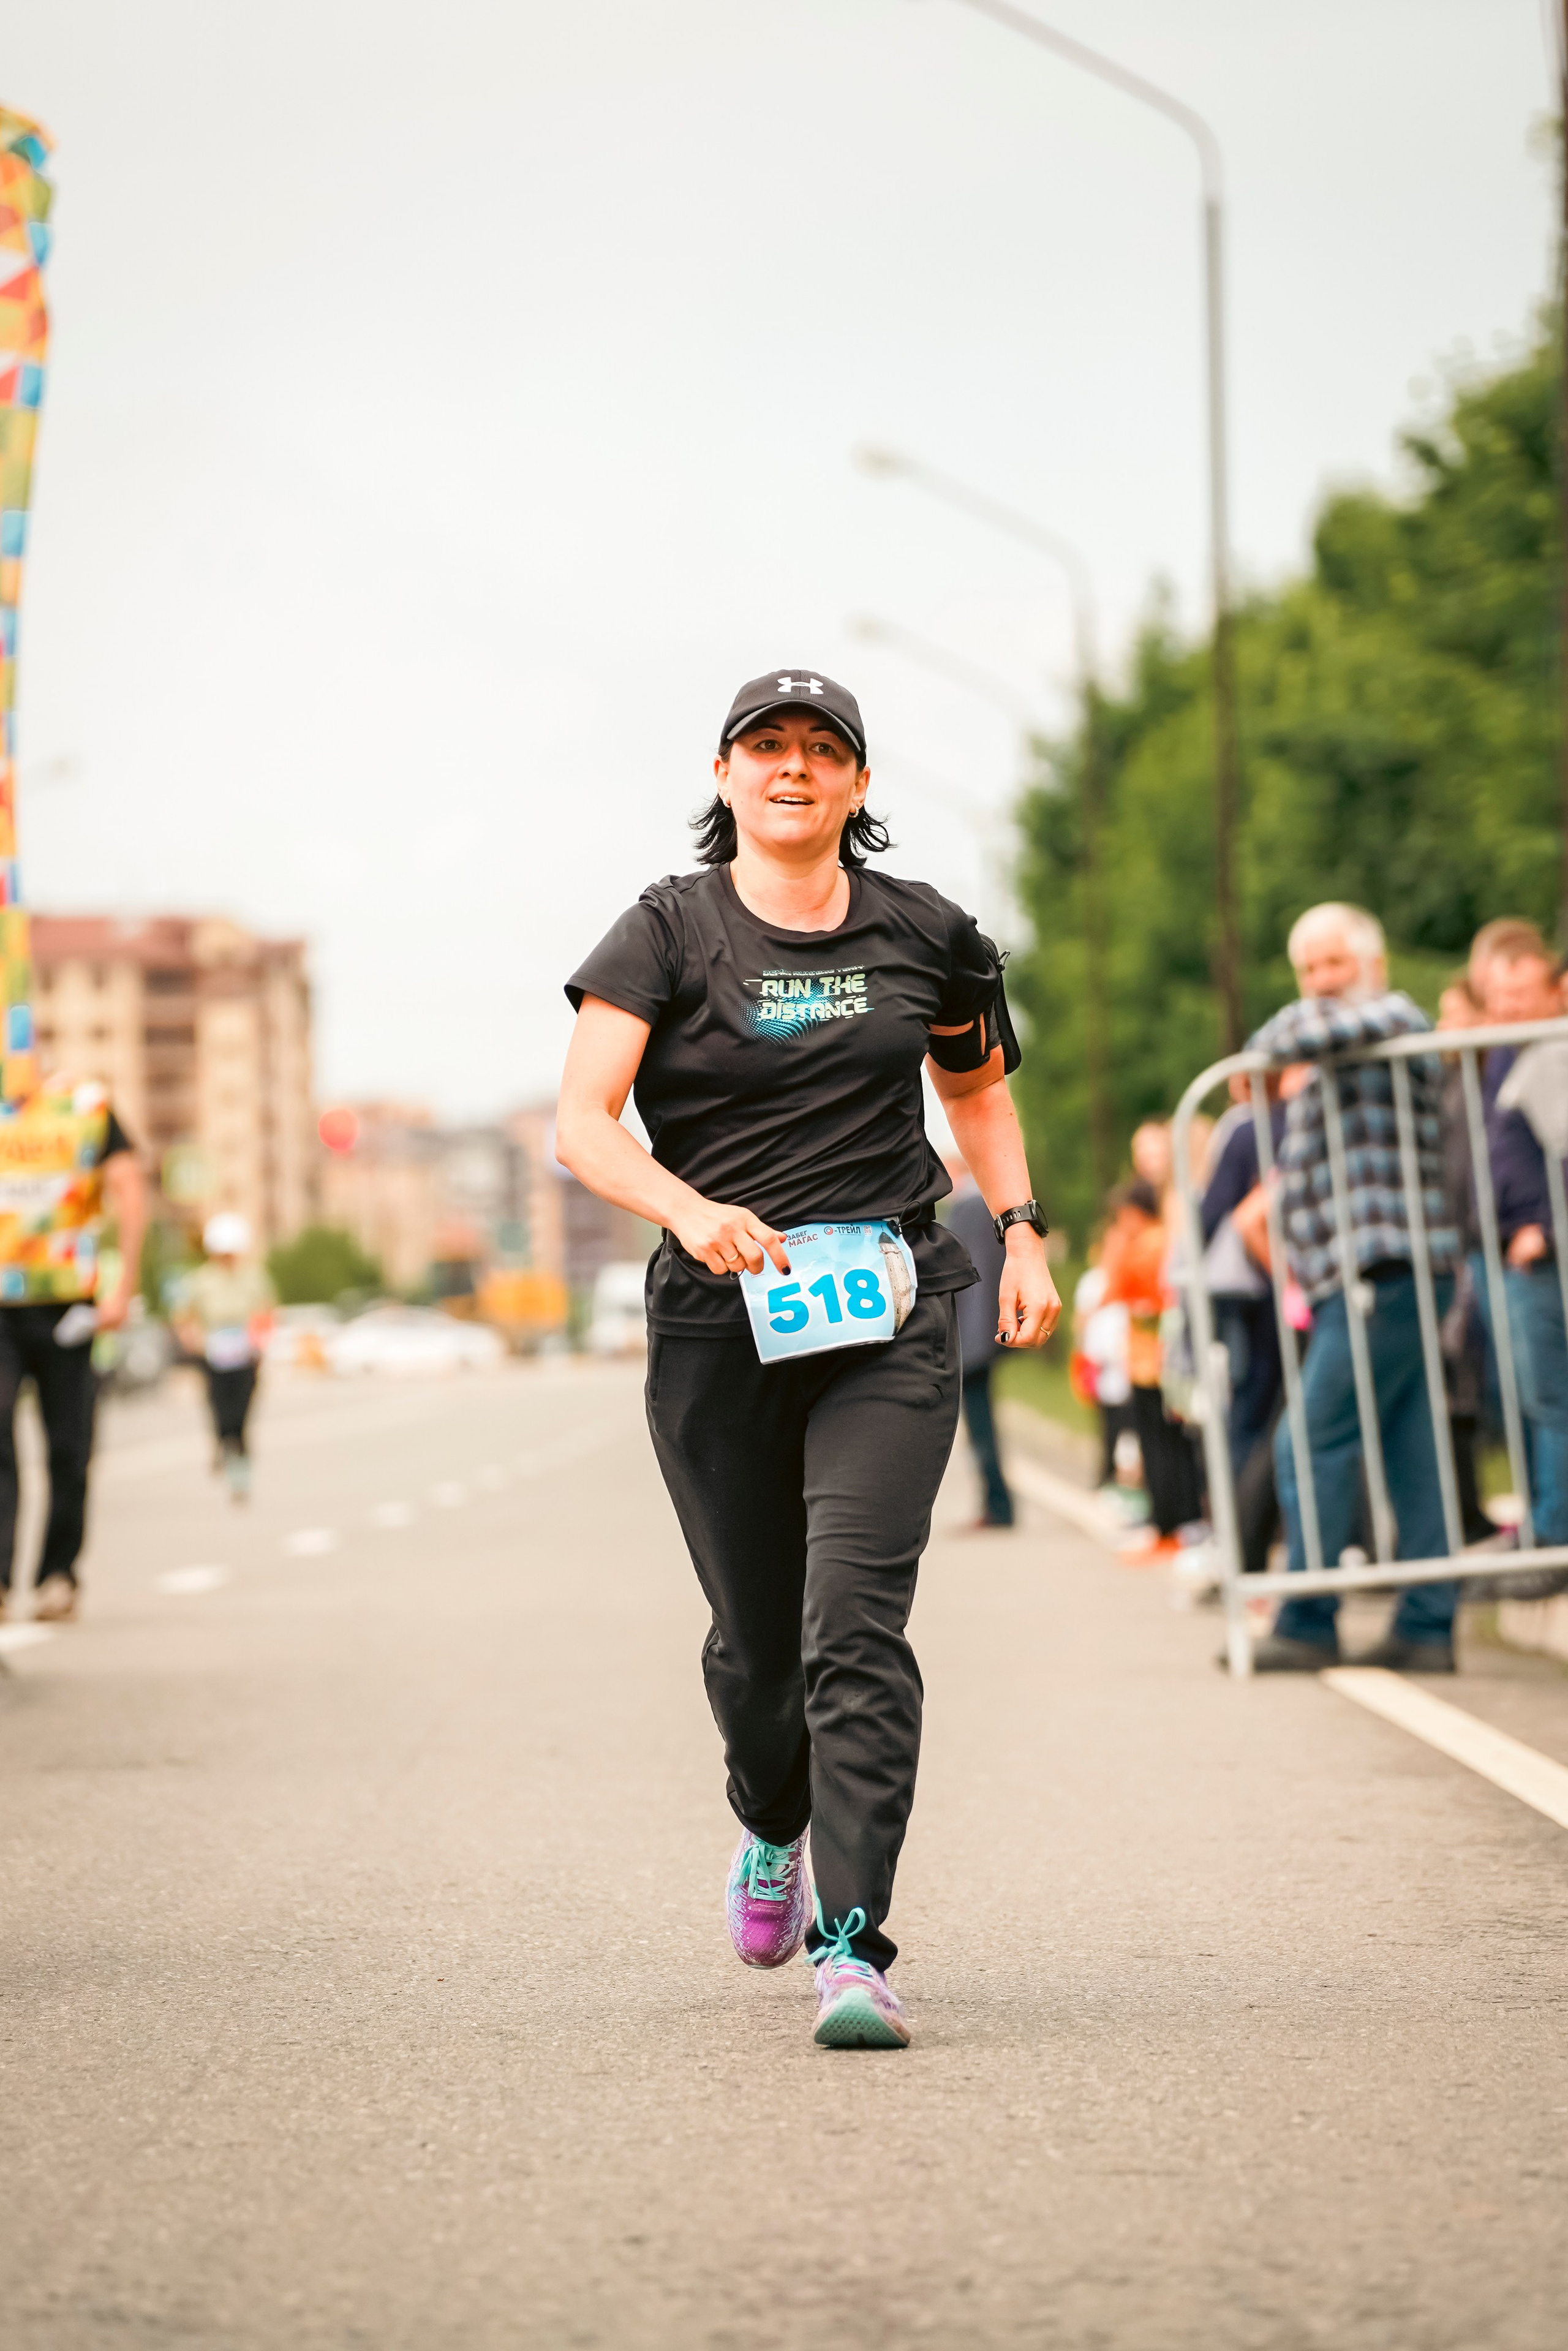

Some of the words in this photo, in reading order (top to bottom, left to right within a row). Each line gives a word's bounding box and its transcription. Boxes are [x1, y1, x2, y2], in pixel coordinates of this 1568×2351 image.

[760, 978, 812, 998] RUN
[818, 973, 867, 997] THE
[760, 997, 869, 1019] DISTANCE
[787, 1230, 807, 1240] ЗАБЕГ
[788, 1233, 818, 1248] МАГАС
[767, 1269, 886, 1334] 518
